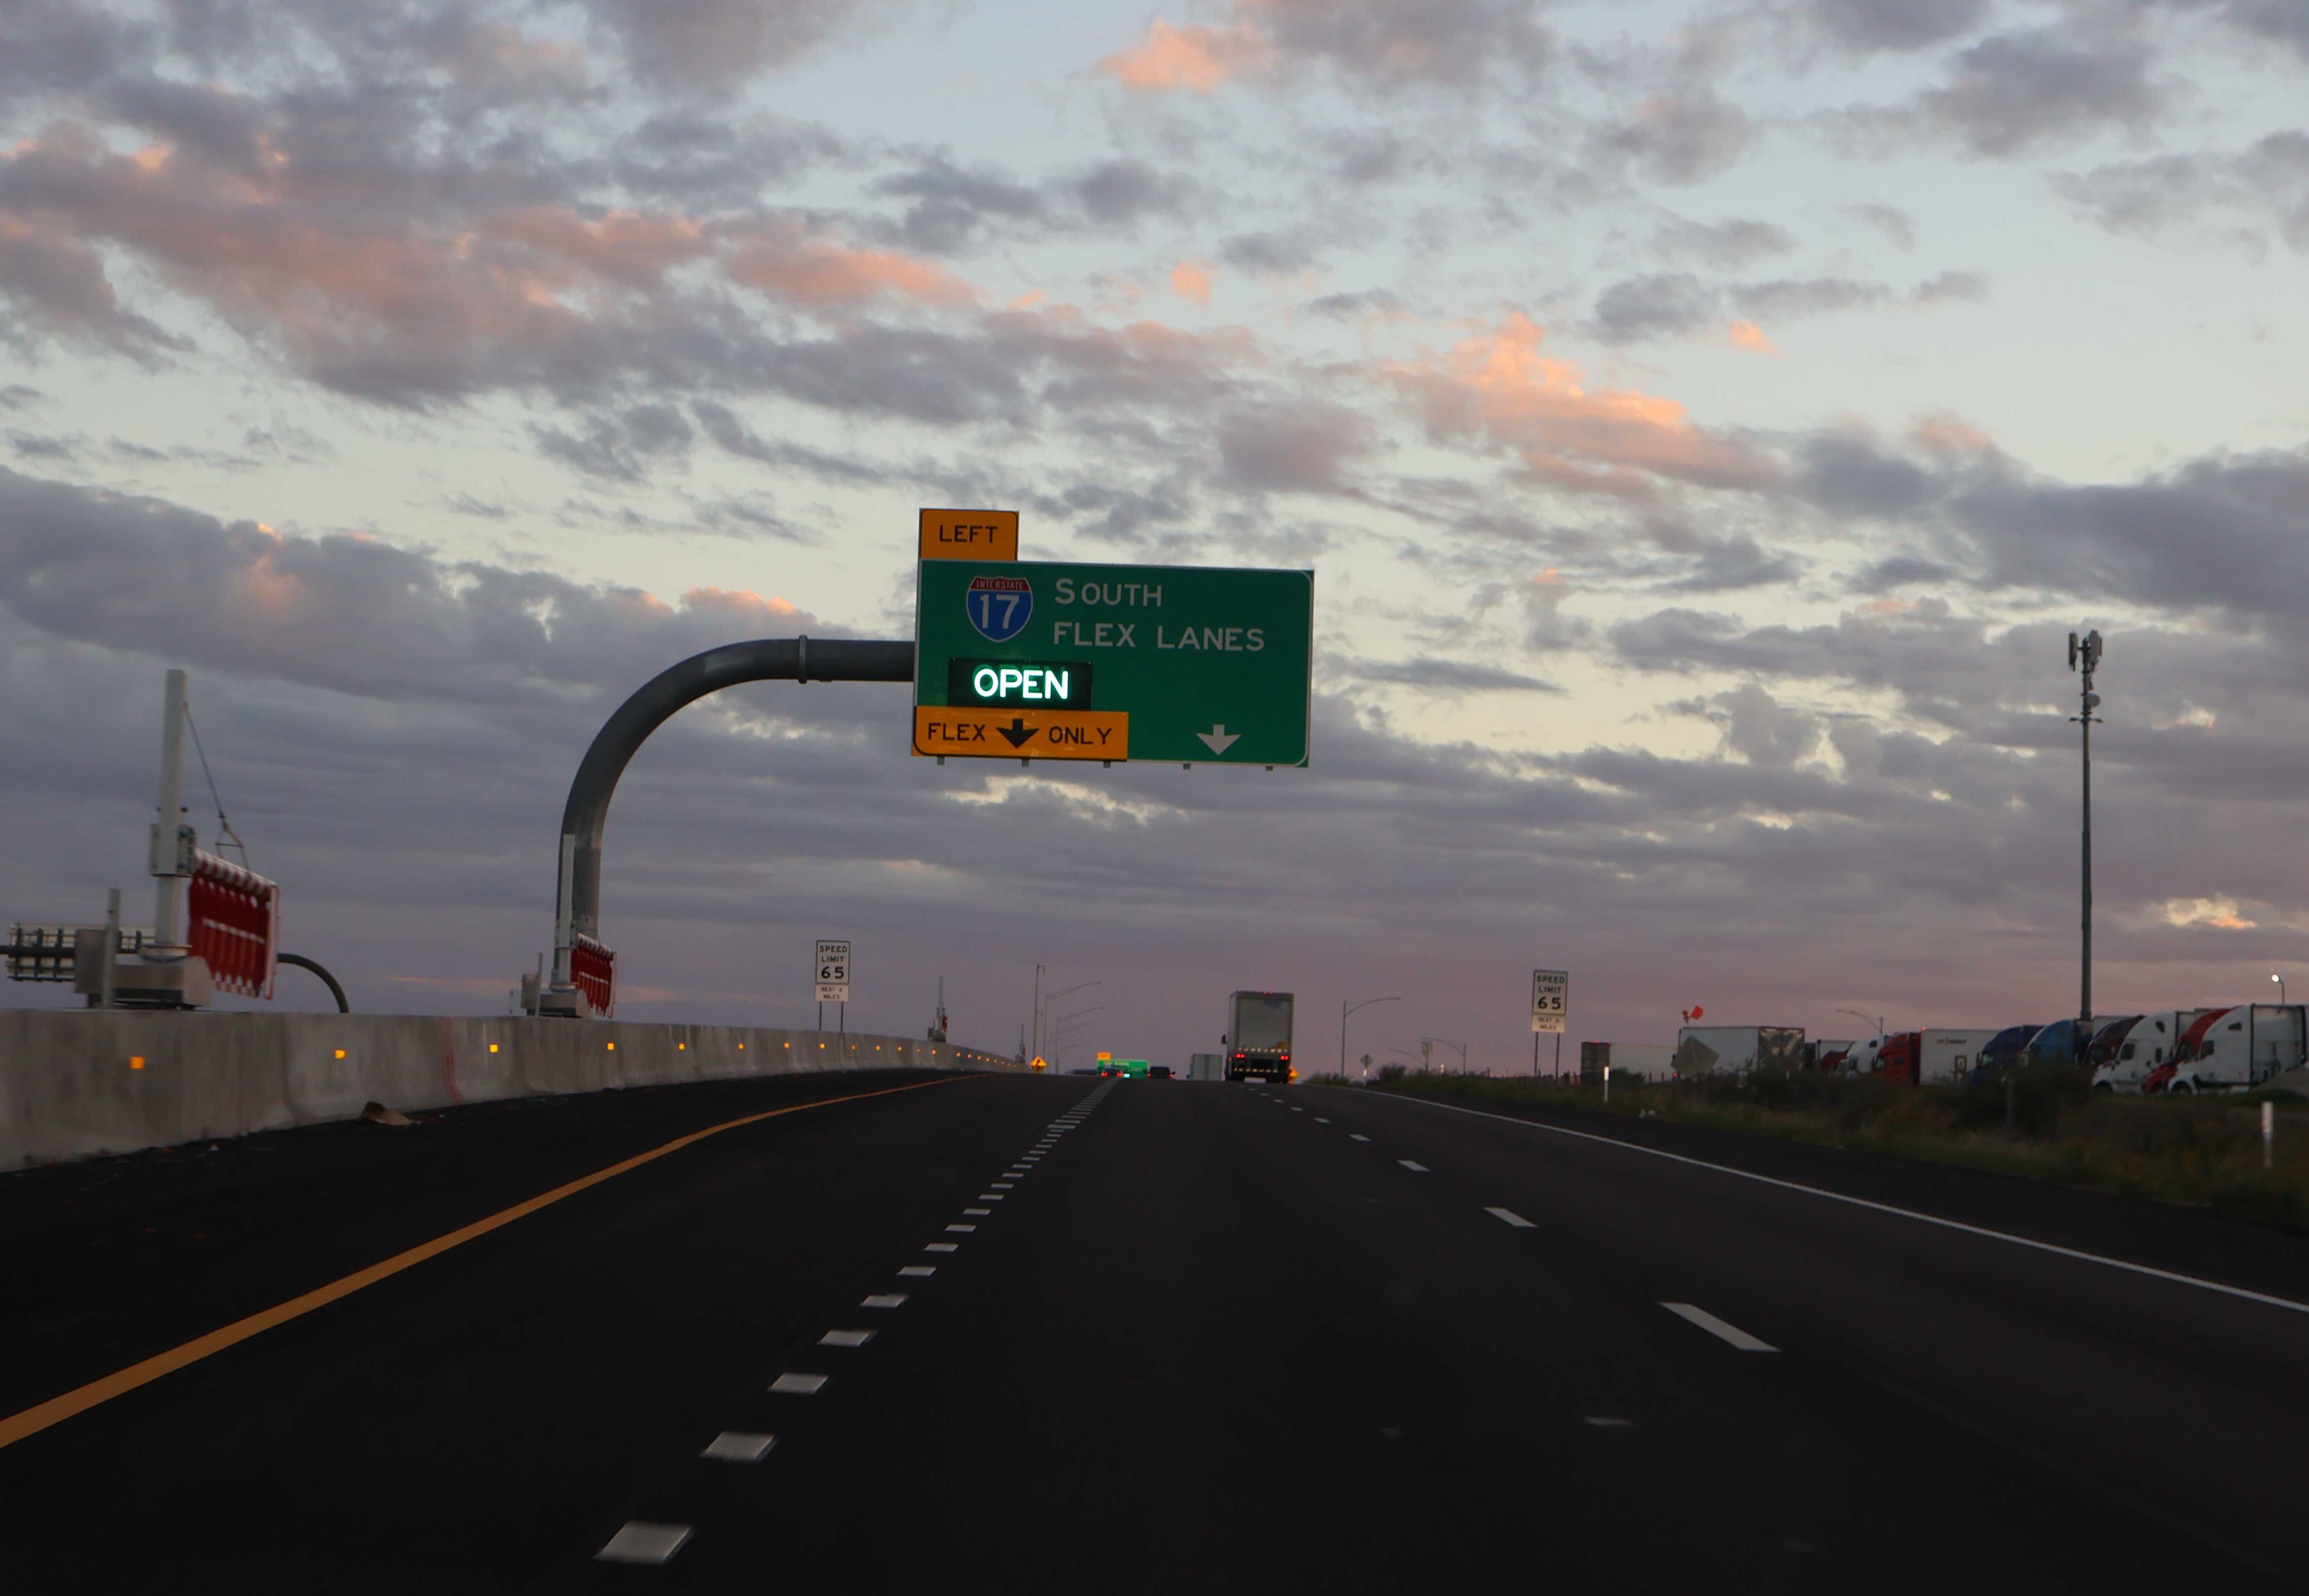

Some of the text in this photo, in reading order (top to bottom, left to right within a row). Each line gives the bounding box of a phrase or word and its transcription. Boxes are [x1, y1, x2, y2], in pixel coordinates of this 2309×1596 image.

[940, 525, 998, 542] LEFT
[976, 580, 1023, 590] INTERSTATE
[1055, 578, 1162, 607] SOUTH
[980, 594, 1020, 629] 17
[1054, 622, 1265, 651] FLEX LANES
[974, 668, 1069, 700] OPEN
[927, 723, 1112, 745] FLEX ONLY
[821, 966, 844, 979] 65
[1538, 997, 1561, 1009] 65
